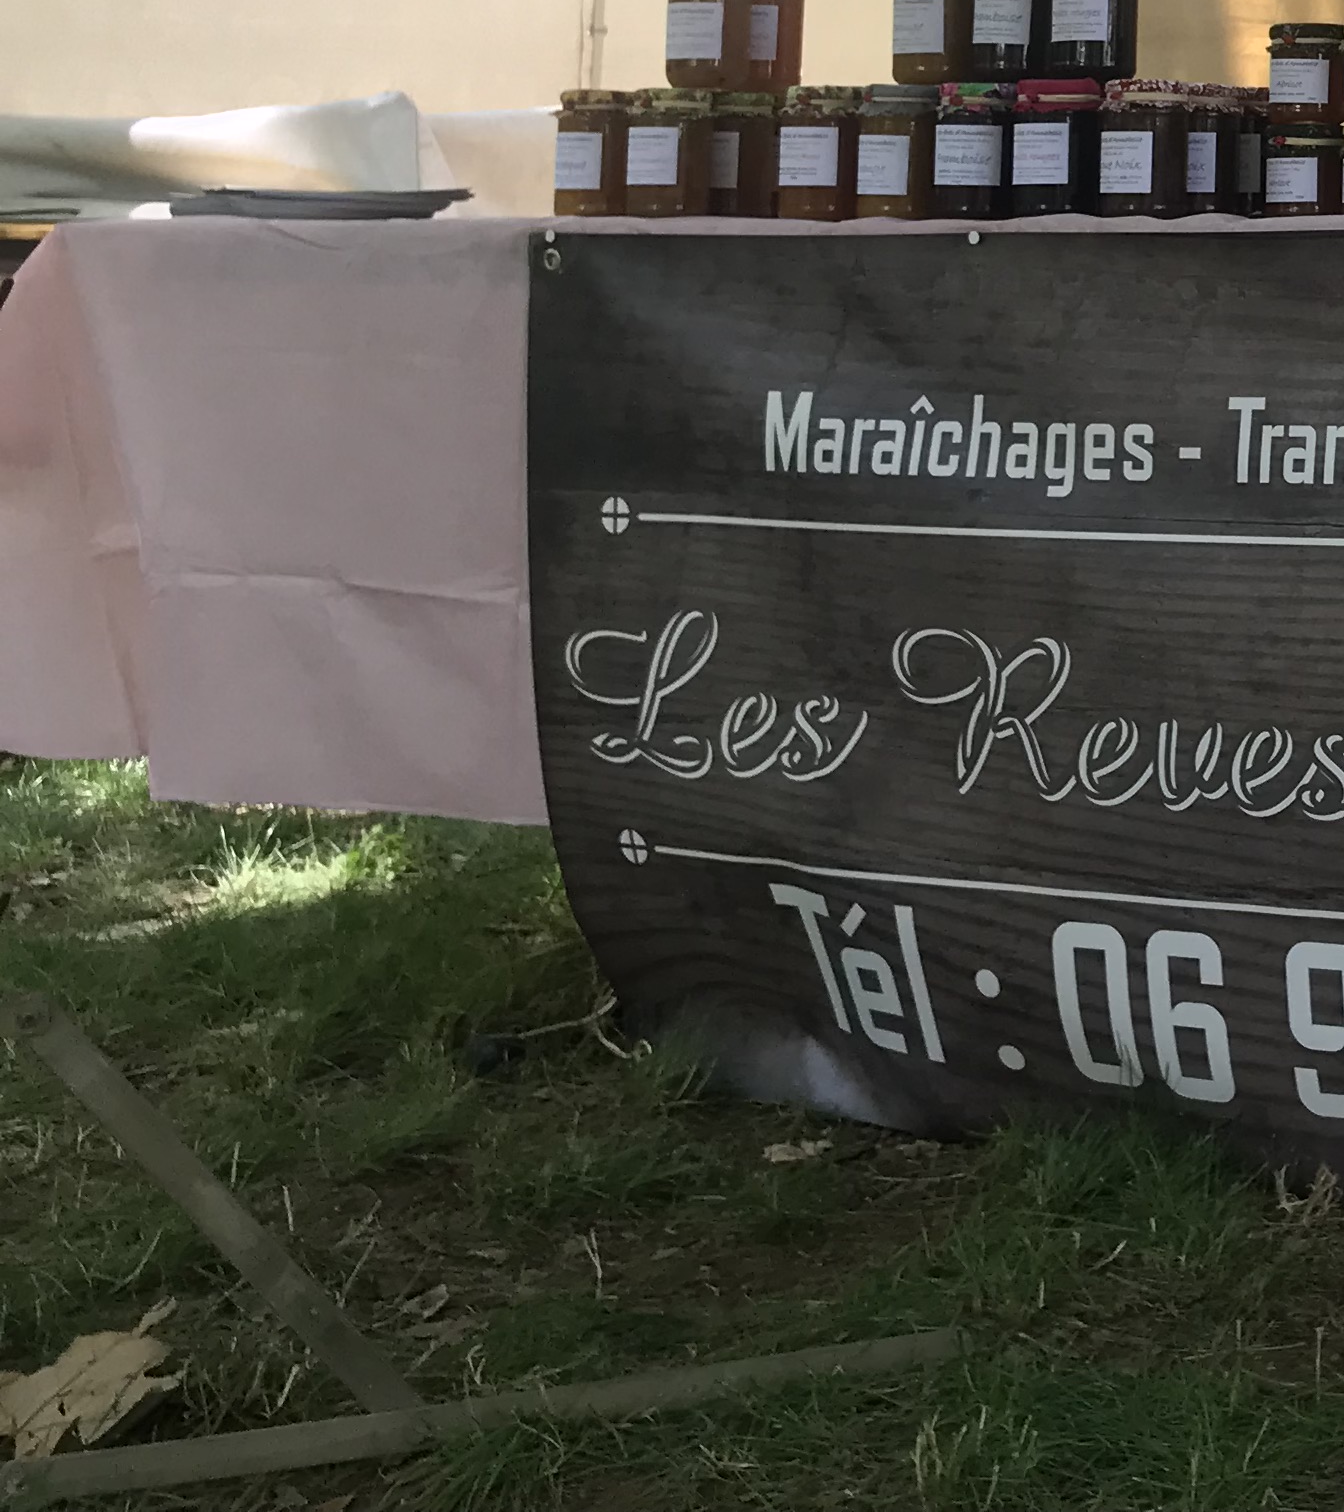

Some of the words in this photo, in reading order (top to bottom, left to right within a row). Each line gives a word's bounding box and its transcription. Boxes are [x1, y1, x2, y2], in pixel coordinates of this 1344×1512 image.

[763, 389, 1155, 498] Maraîchages
[564, 609, 867, 782] Les
[1051, 921, 1237, 1104] 06
